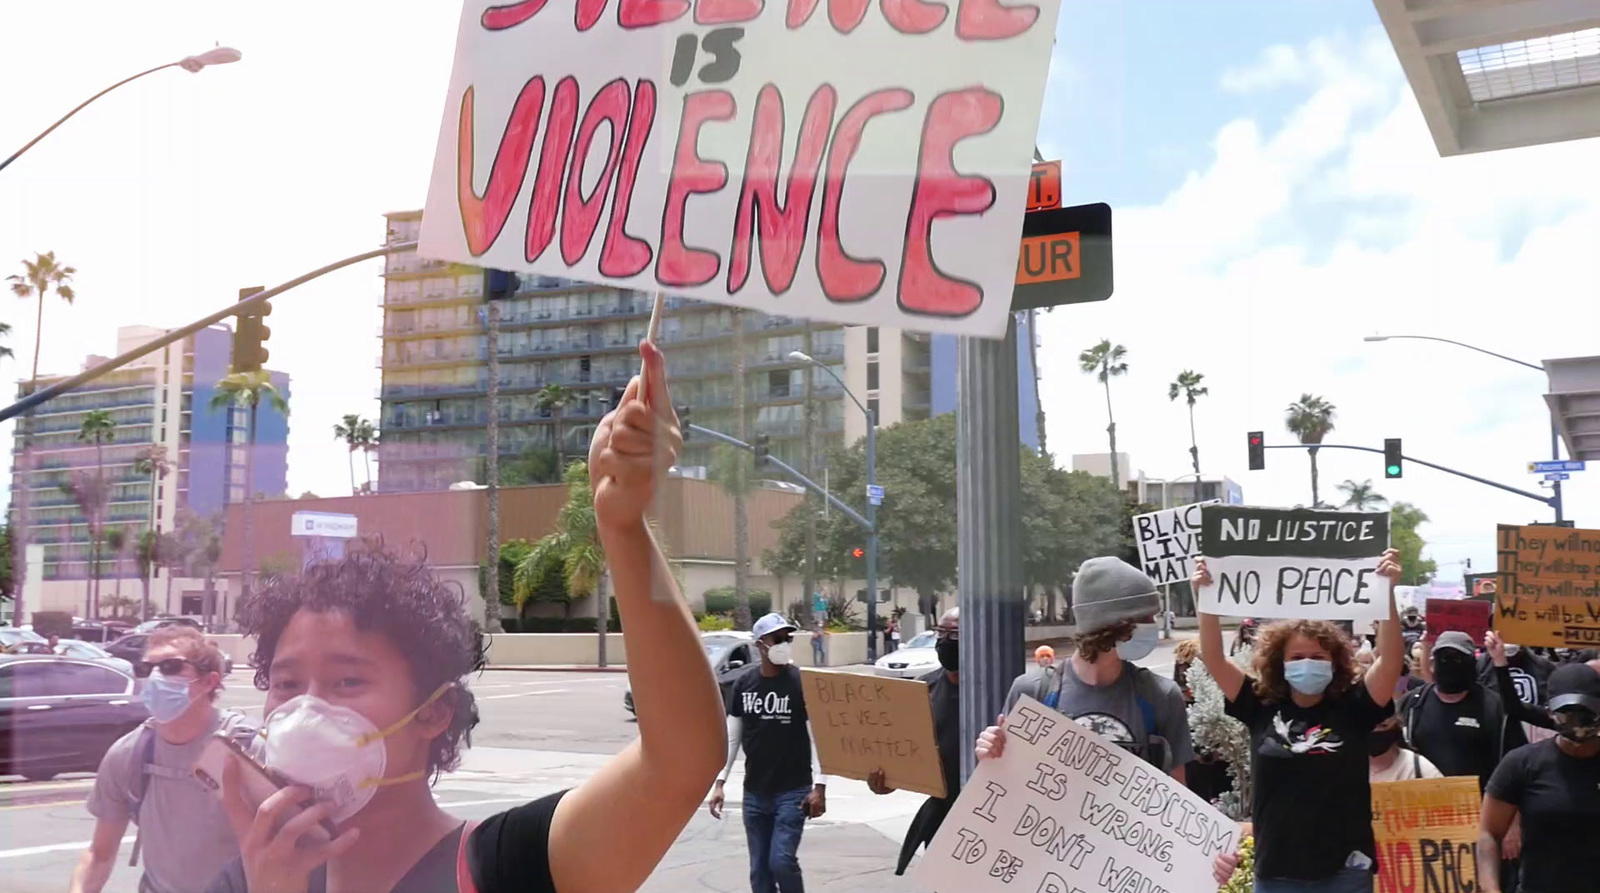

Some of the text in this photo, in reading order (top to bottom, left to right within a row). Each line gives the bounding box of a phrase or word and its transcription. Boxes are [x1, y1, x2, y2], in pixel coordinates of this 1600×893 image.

[669, 28, 744, 86] IS
[457, 74, 1004, 317] VIOLENCE
[1017, 239, 1073, 277] UR
[1138, 505, 1201, 541] BLAC
[1219, 518, 1374, 542] NO JUSTICE
[1497, 524, 1547, 560] They
[1145, 557, 1187, 583] MAT
[1218, 570, 1260, 605] NO
[1277, 566, 1377, 605] PEACE
[1497, 595, 1528, 621] We
[1562, 605, 1585, 623] be
[741, 691, 792, 714] We Out.
[815, 677, 891, 703] BLACK
[826, 710, 893, 727] LIVES
[841, 736, 921, 758] MATTER
[1007, 706, 1234, 857] IF ANTI-FASCISM
[1026, 762, 1174, 872] IS WRONG,
[972, 780, 1007, 823] I
[1013, 804, 1095, 870] DON'T
[1098, 856, 1170, 893] WA
[951, 827, 987, 864] TO
[989, 849, 1024, 884] BE
[1374, 841, 1415, 893] NO
